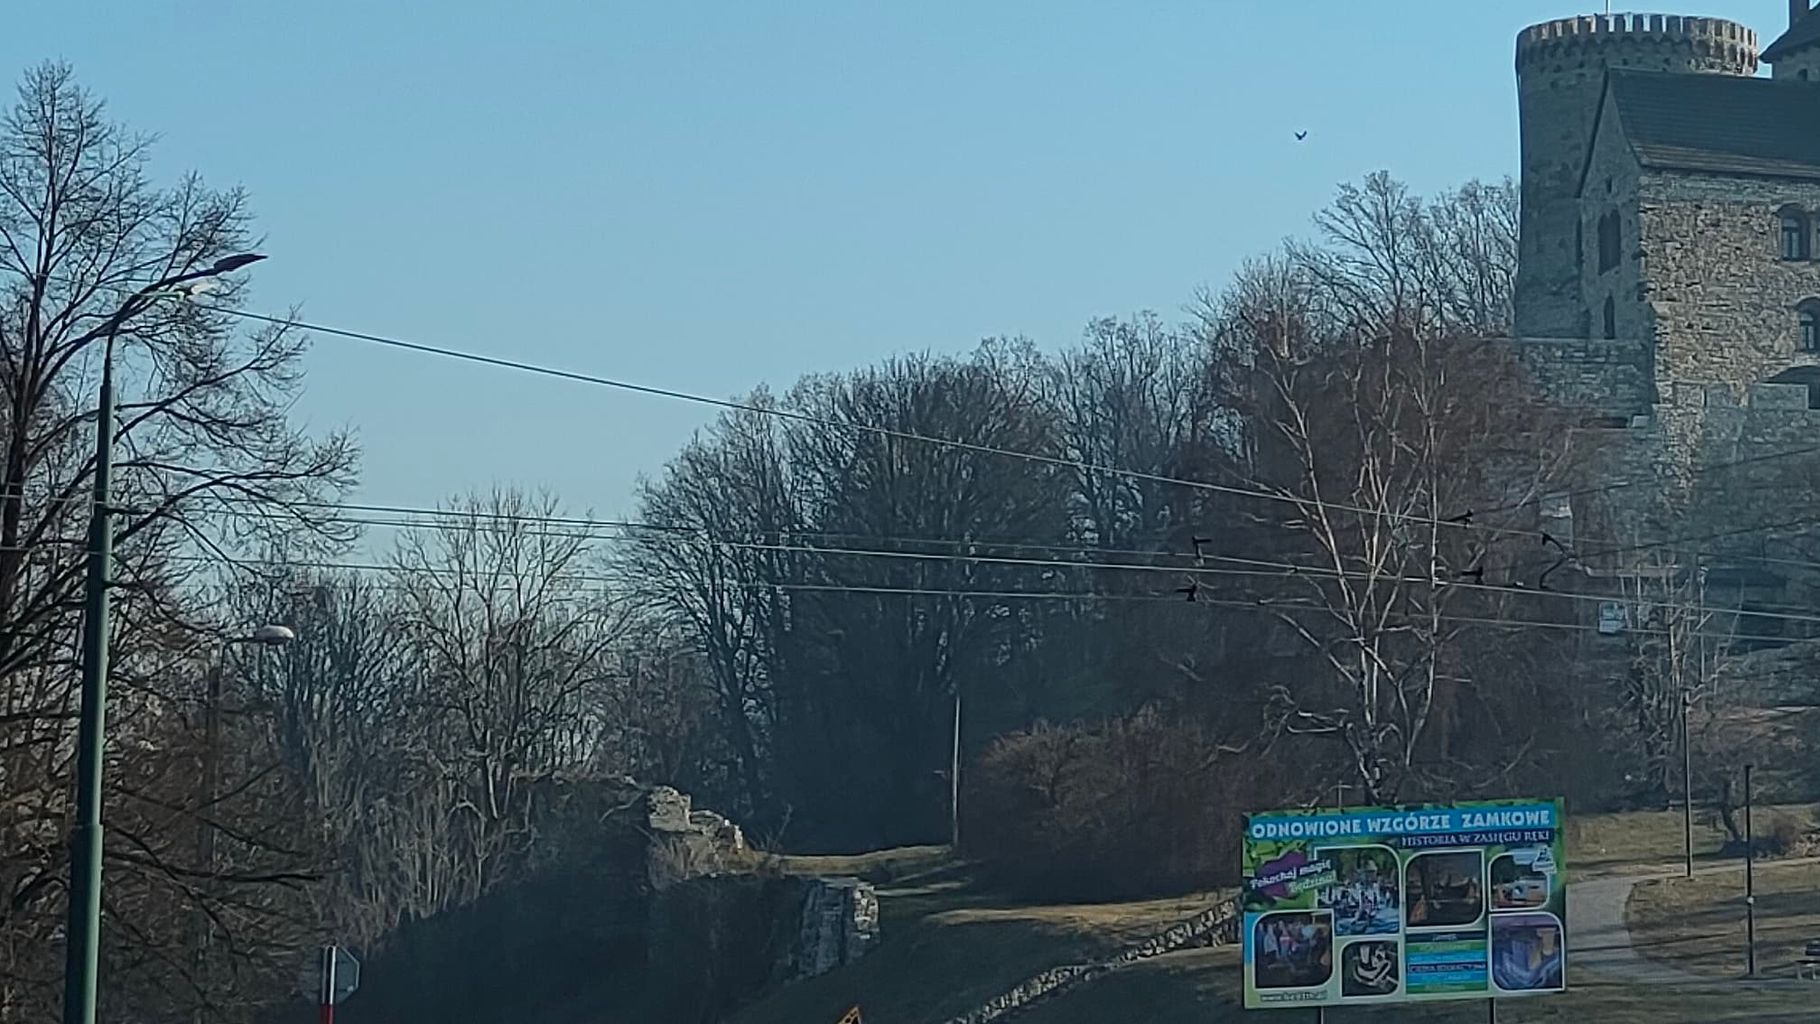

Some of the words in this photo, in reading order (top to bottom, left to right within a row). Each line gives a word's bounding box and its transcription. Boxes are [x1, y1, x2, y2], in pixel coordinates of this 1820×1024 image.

[1252, 819, 1362, 839] ODNOWIONE
[1367, 812, 1451, 833] WZGÓRZE
[1461, 810, 1550, 828] ZAMKOWE
[1402, 834, 1457, 847] HISTORIA
[1459, 833, 1471, 844] W
